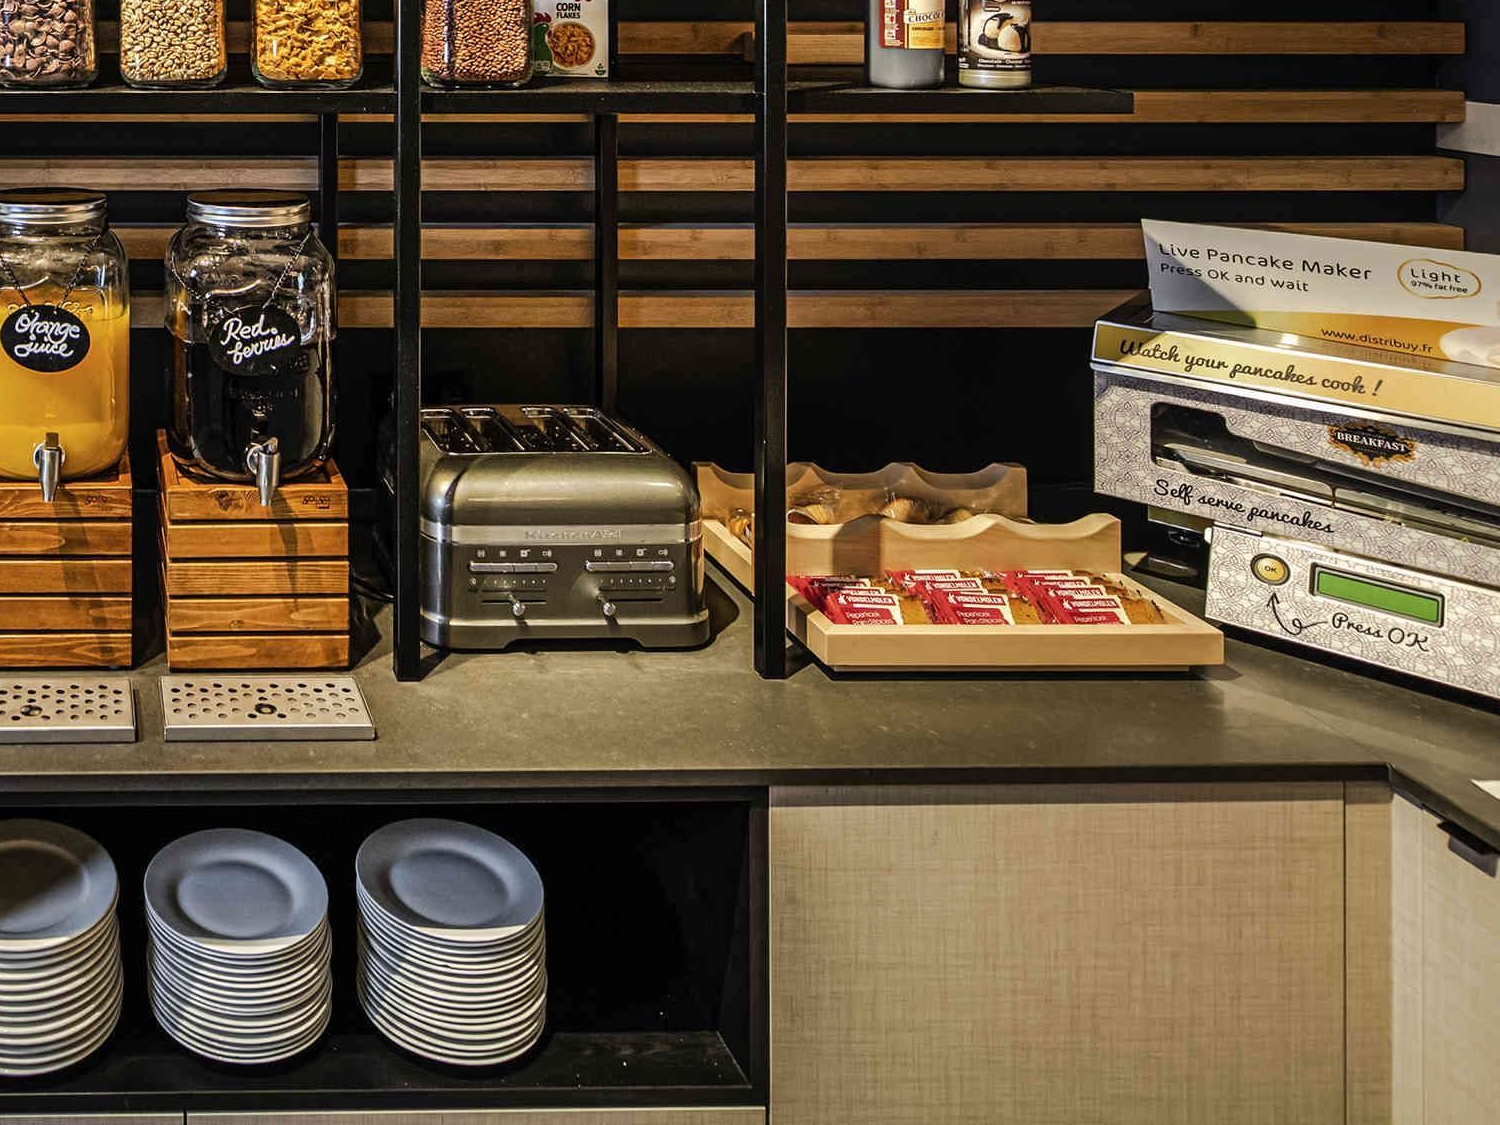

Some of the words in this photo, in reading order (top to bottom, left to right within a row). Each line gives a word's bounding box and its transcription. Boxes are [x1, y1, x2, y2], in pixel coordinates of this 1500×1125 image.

[556, 3, 581, 12] CORN
[1158, 243, 1200, 259] Live
[1207, 249, 1294, 270] Pancake
[1302, 260, 1372, 280] Maker
[1410, 268, 1461, 284] Light
[1160, 263, 1202, 277] Press
[1207, 269, 1230, 281] OK
[1235, 274, 1265, 286] and
[1271, 278, 1309, 292] wait
[1410, 280, 1433, 289] 97%
[1449, 285, 1468, 293] free
[15, 312, 80, 344] Orange
[220, 314, 271, 345] Red
[1321, 328, 1434, 354] www.distribuy.fr
[1119, 339, 1181, 362] Watch
[1184, 354, 1229, 372] your
[1229, 362, 1318, 386] pancakes
[1321, 375, 1367, 396] cook
[1336, 432, 1406, 452] BREAKFAST
[1153, 478, 1194, 506] Self
[1197, 494, 1245, 514] serve
[1246, 505, 1335, 534] pancakes
[1263, 565, 1278, 574] OK
[1331, 612, 1384, 639] Press
[1387, 627, 1429, 652] OK
